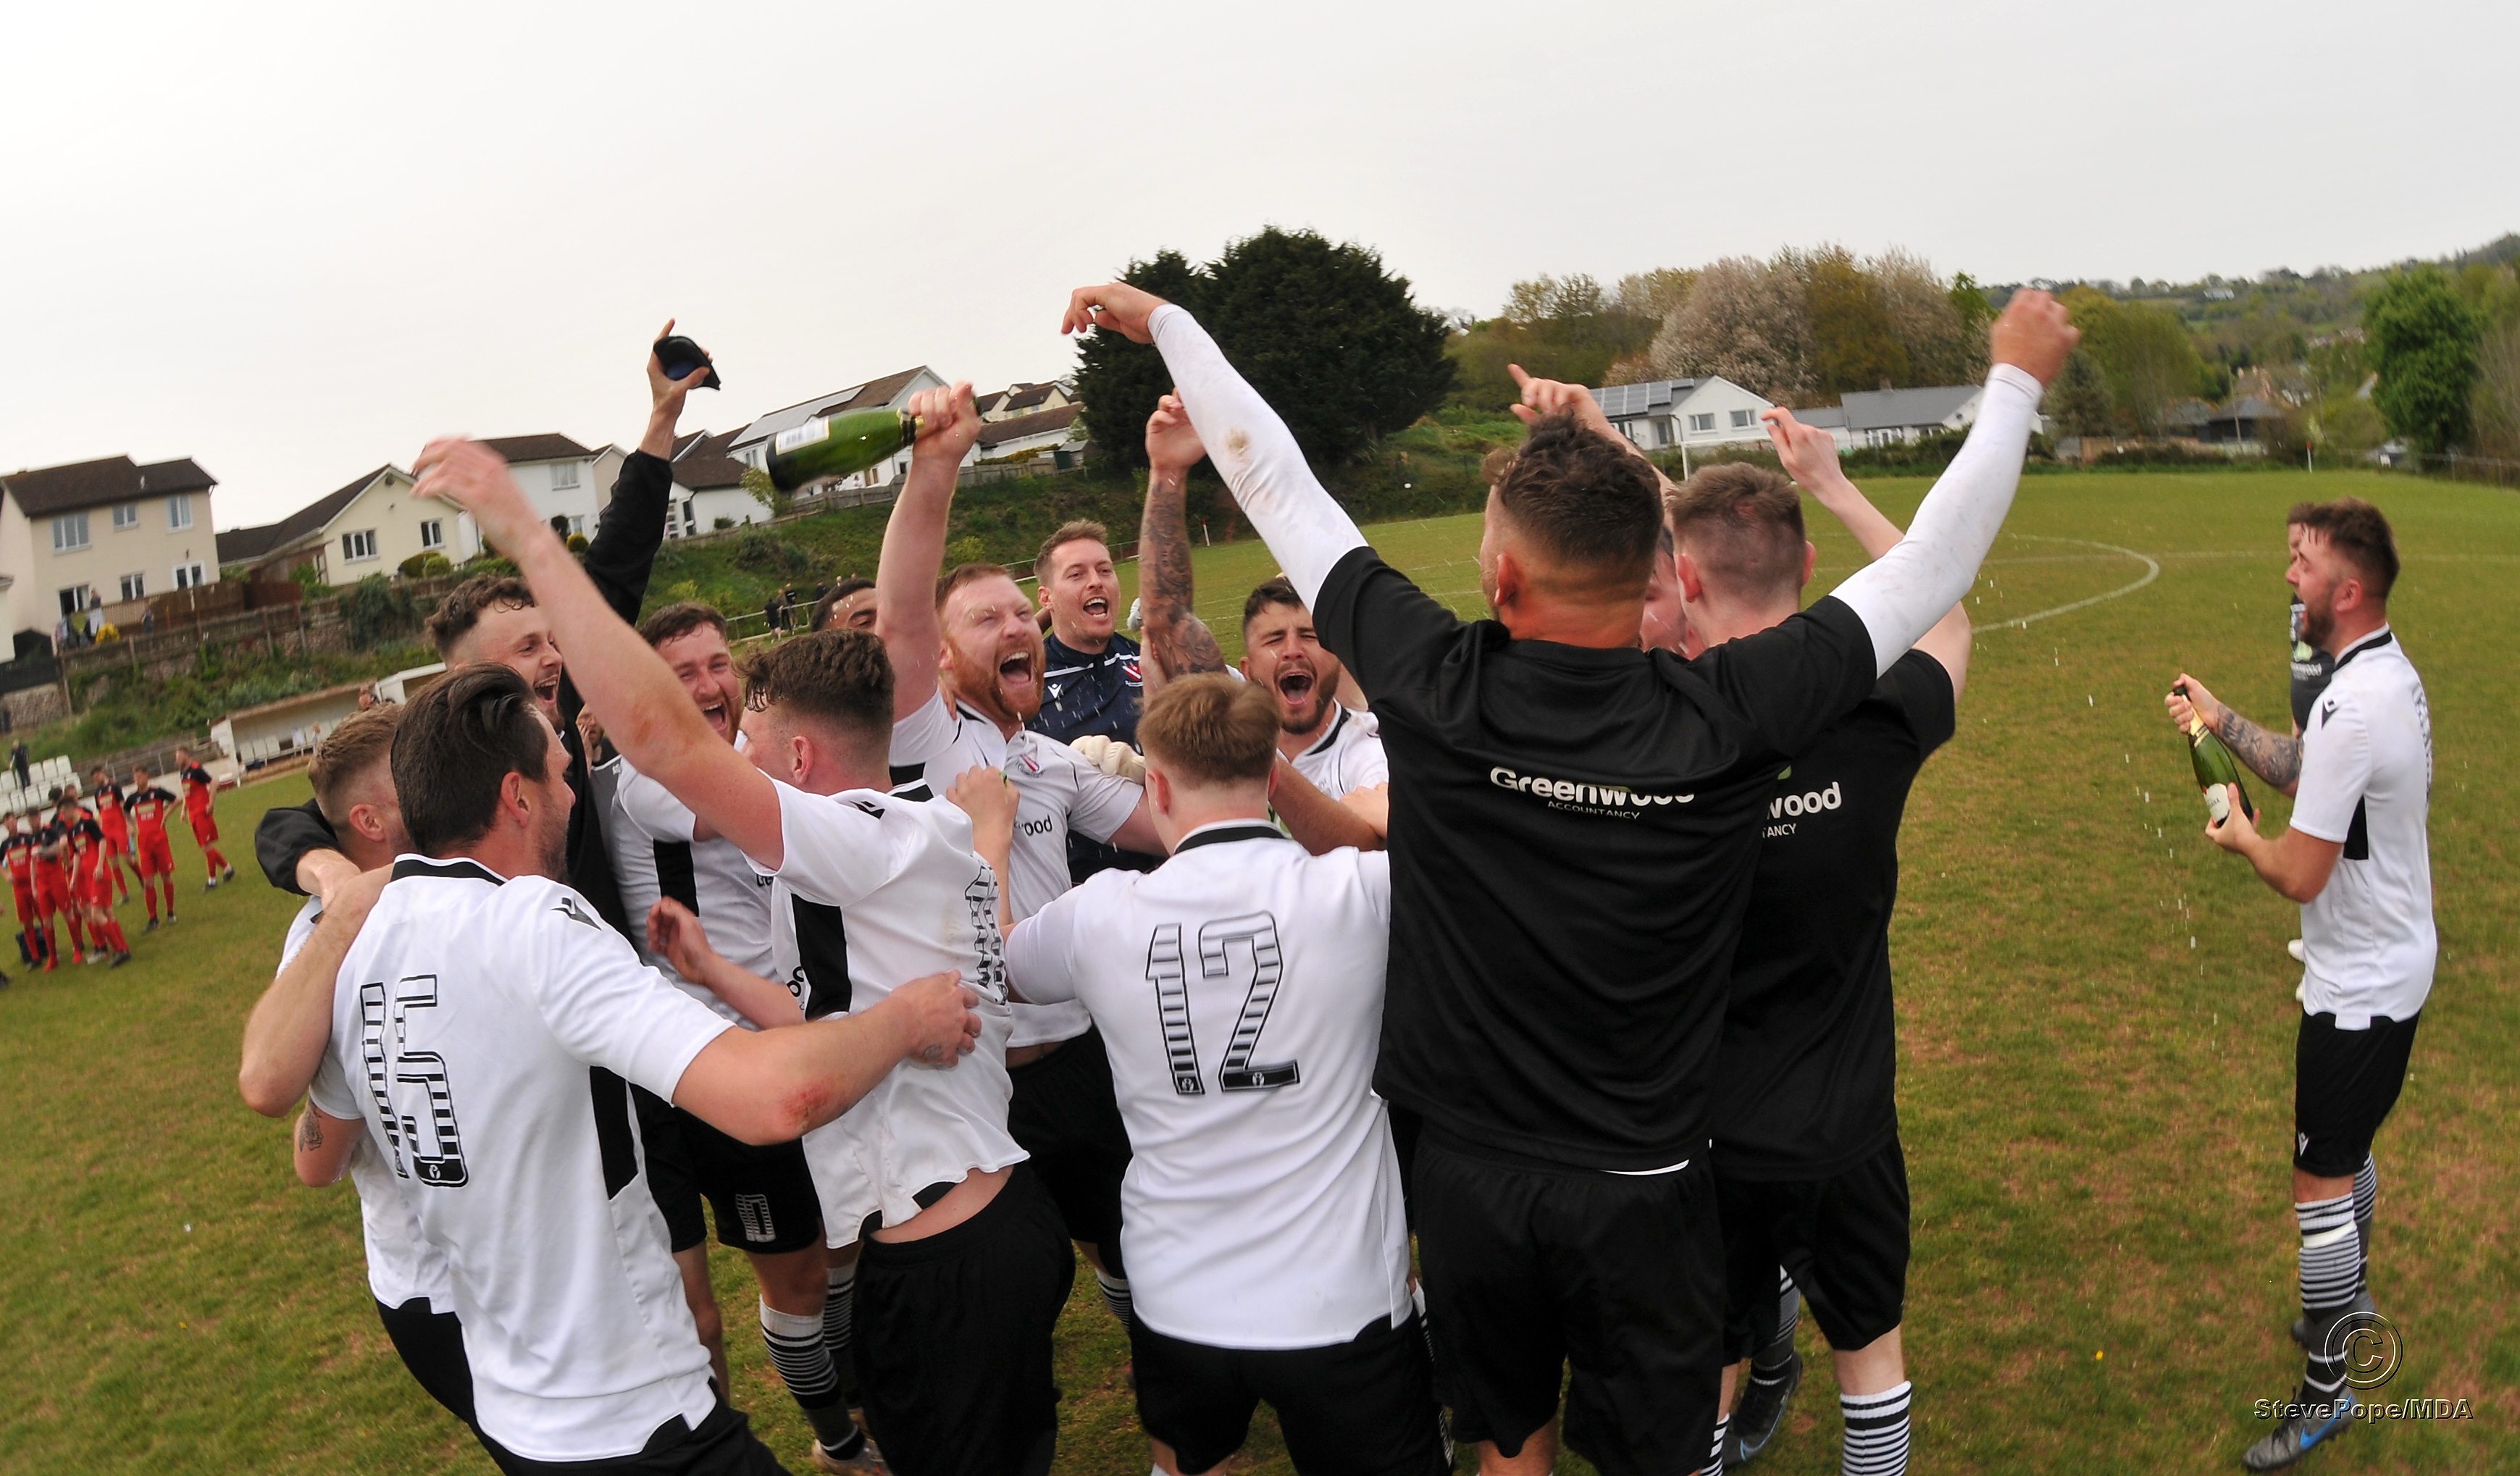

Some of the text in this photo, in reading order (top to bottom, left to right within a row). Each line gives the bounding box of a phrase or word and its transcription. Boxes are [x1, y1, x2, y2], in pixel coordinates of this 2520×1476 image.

[1547, 800, 1641, 820] ACCOUNTANCY
[1145, 910, 1301, 1095] 12
[361, 973, 469, 1188] 15
[735, 1194, 776, 1242] 10
